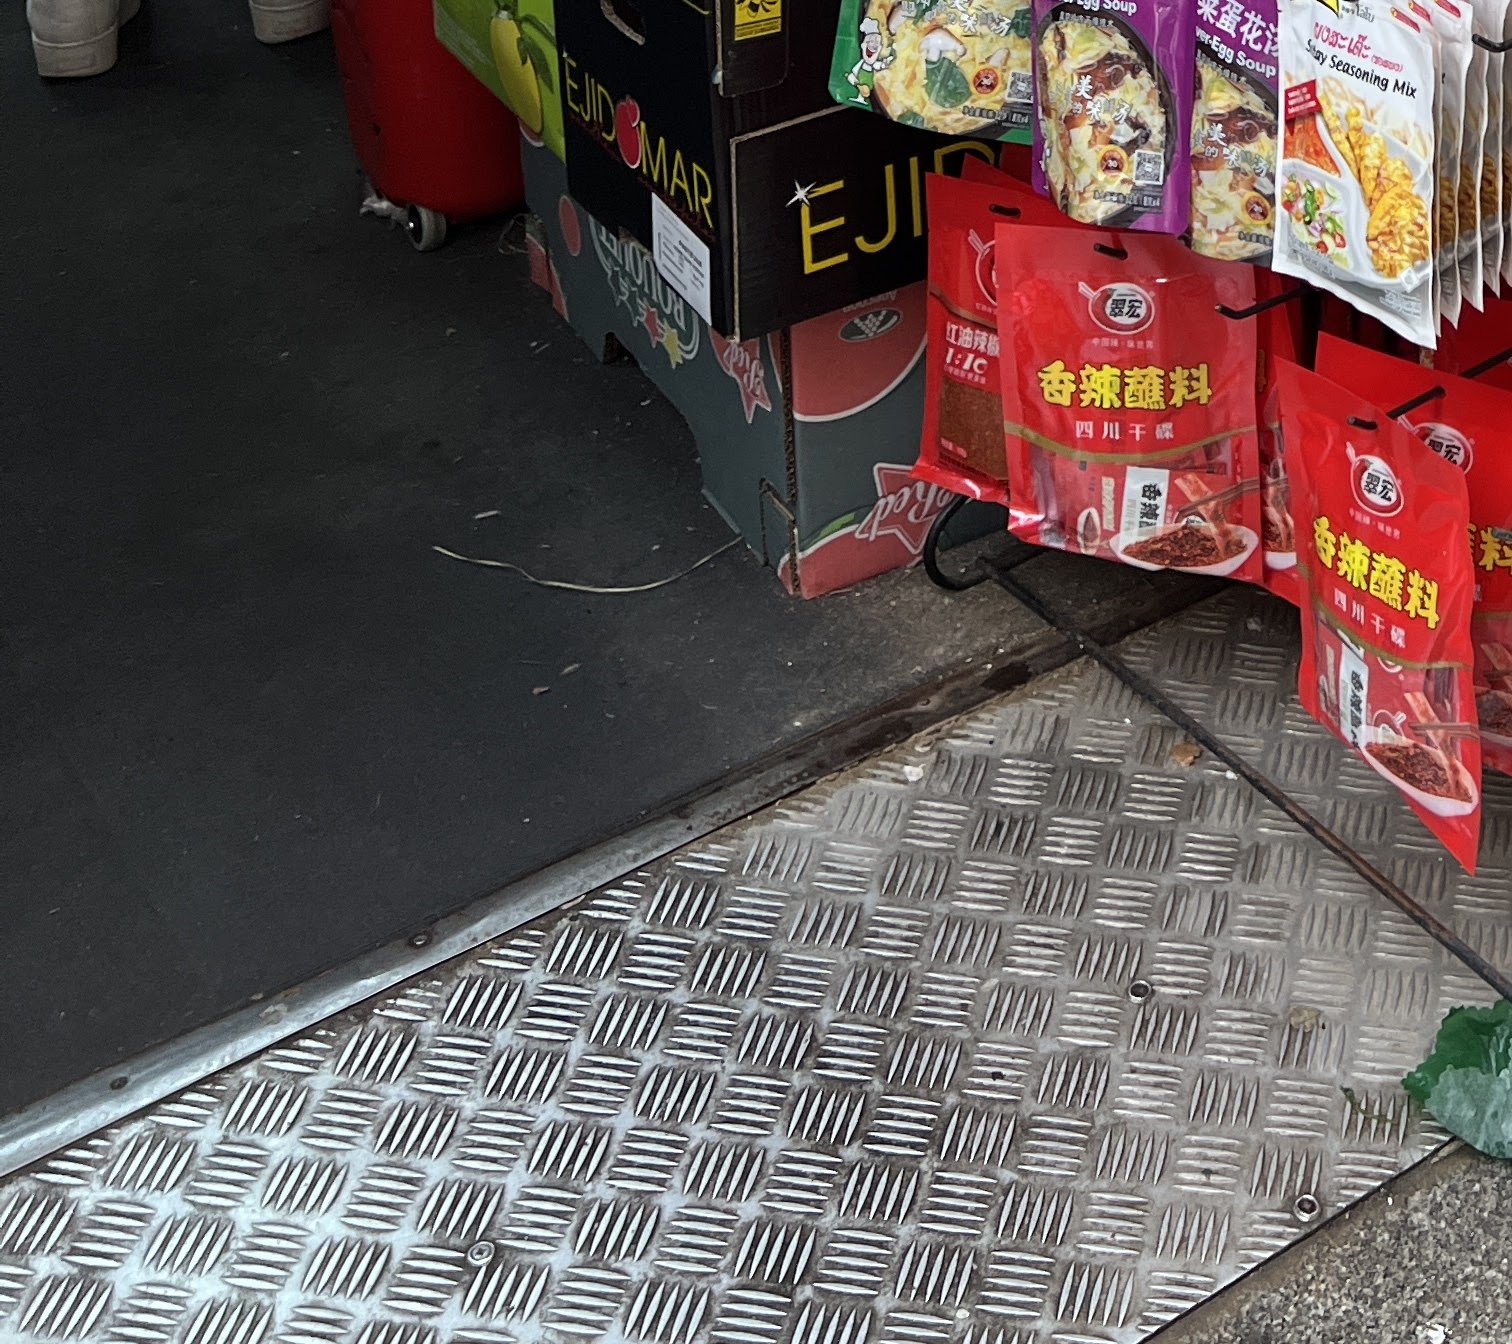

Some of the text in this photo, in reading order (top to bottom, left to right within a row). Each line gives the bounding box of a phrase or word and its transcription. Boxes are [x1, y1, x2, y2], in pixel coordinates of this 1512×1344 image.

[1195, 25, 1277, 80] ver-Egg Soup
[1328, 55, 1418, 100] Seasoning Mix
[1036, 359, 1214, 411] 香辣蘸料
[1074, 420, 1175, 441] 四川干碟
[1311, 515, 1441, 630] 香辣蘸料
